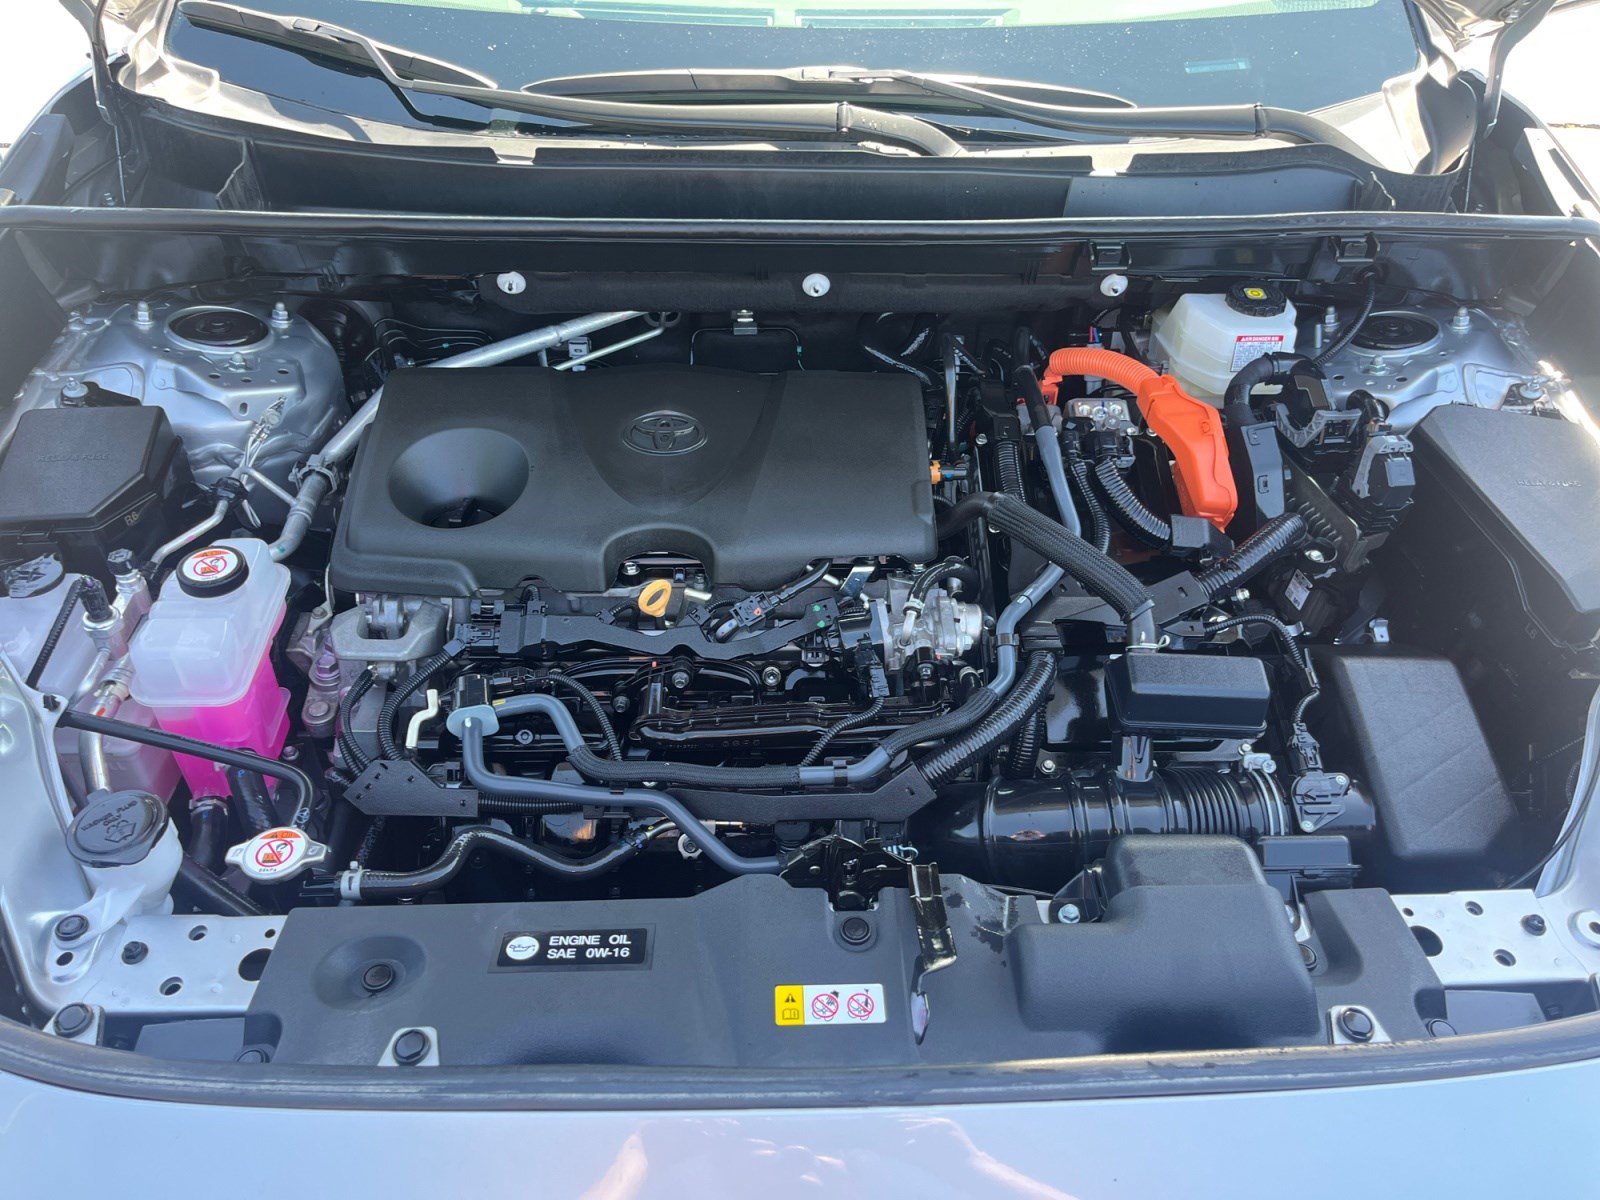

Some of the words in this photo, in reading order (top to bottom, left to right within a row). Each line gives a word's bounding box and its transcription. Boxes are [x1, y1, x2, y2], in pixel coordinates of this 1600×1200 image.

[549, 935, 601, 946] ENGINE
[608, 934, 632, 945] OIL
[546, 948, 577, 959] SAE
[585, 947, 630, 958] 0W-16
